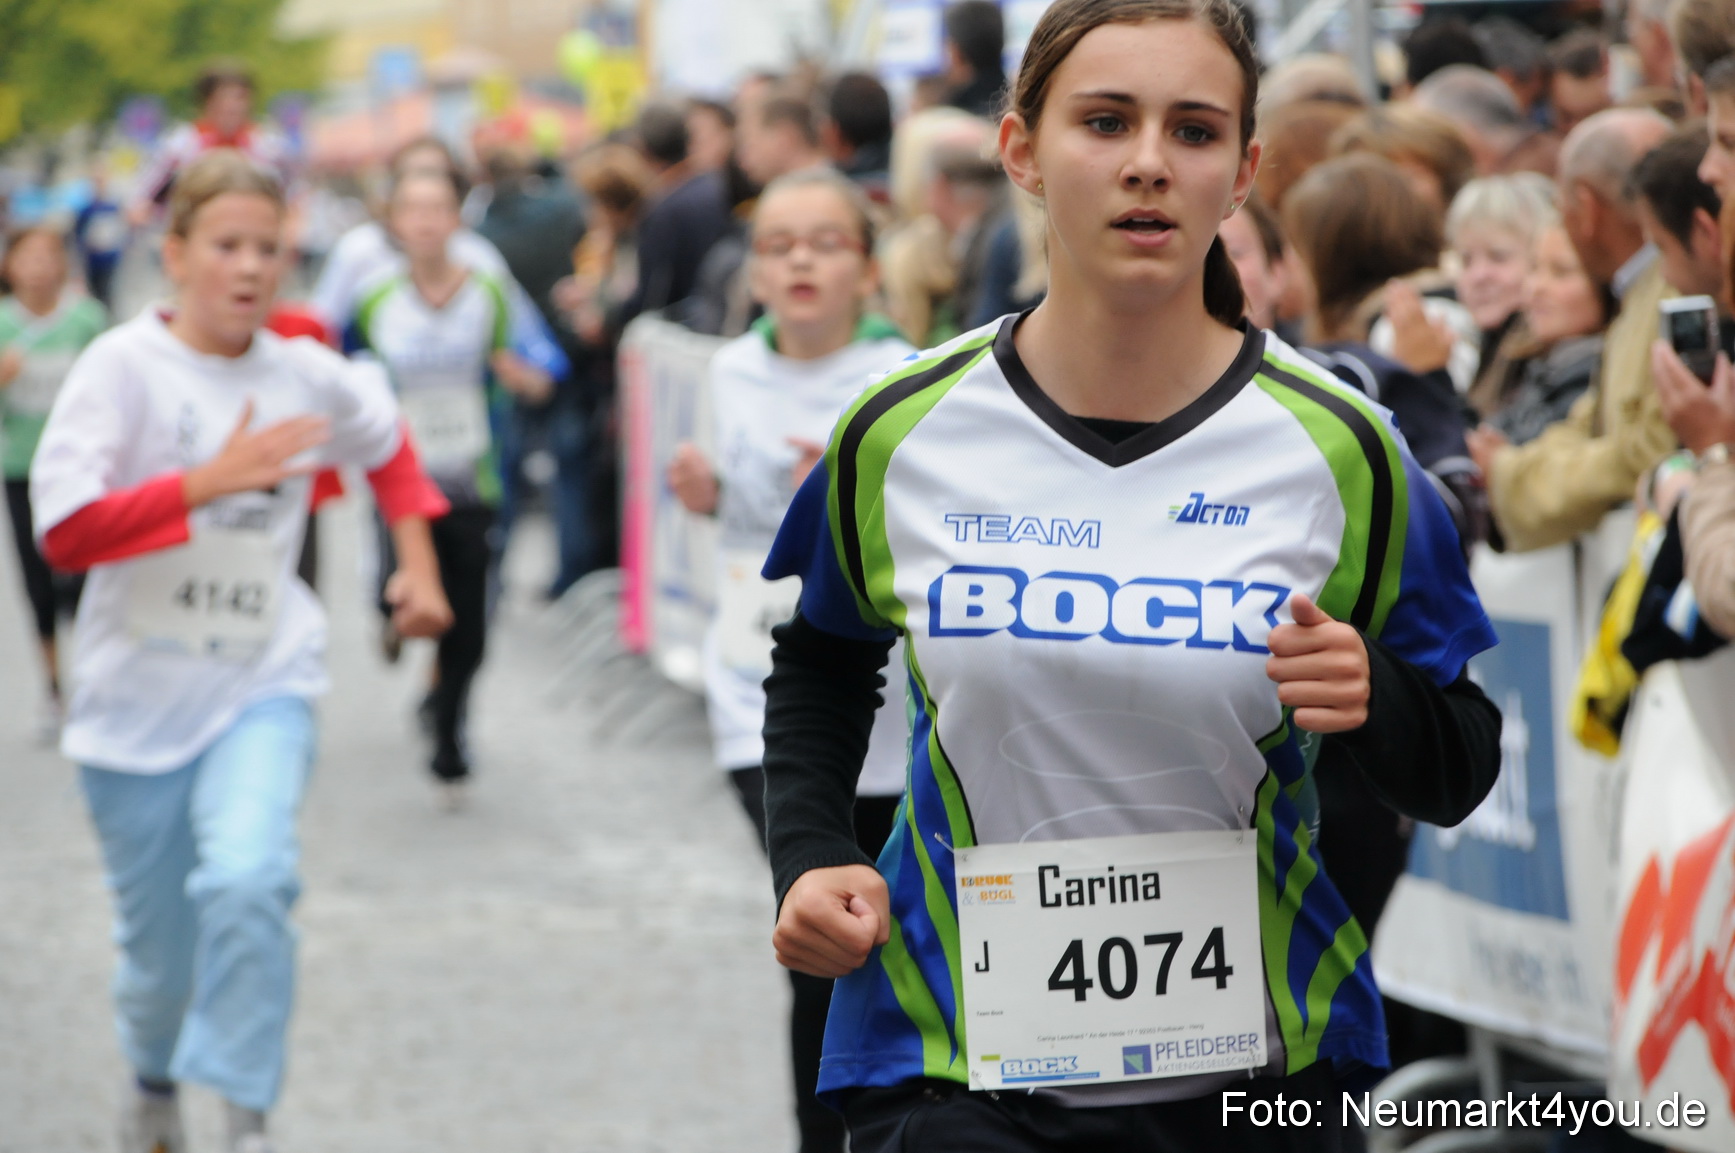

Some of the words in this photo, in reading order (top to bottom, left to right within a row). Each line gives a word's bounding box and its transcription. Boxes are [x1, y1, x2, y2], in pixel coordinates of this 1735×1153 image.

[944, 513, 1102, 549] TEAM
[928, 565, 1292, 655] BOCK
[1038, 865, 1161, 908] Carina
[975, 940, 990, 973] J
[1048, 926, 1234, 1003] 4074
[1155, 1033, 1260, 1061] PFLEIDERER
[1001, 1056, 1079, 1076] BOCK
